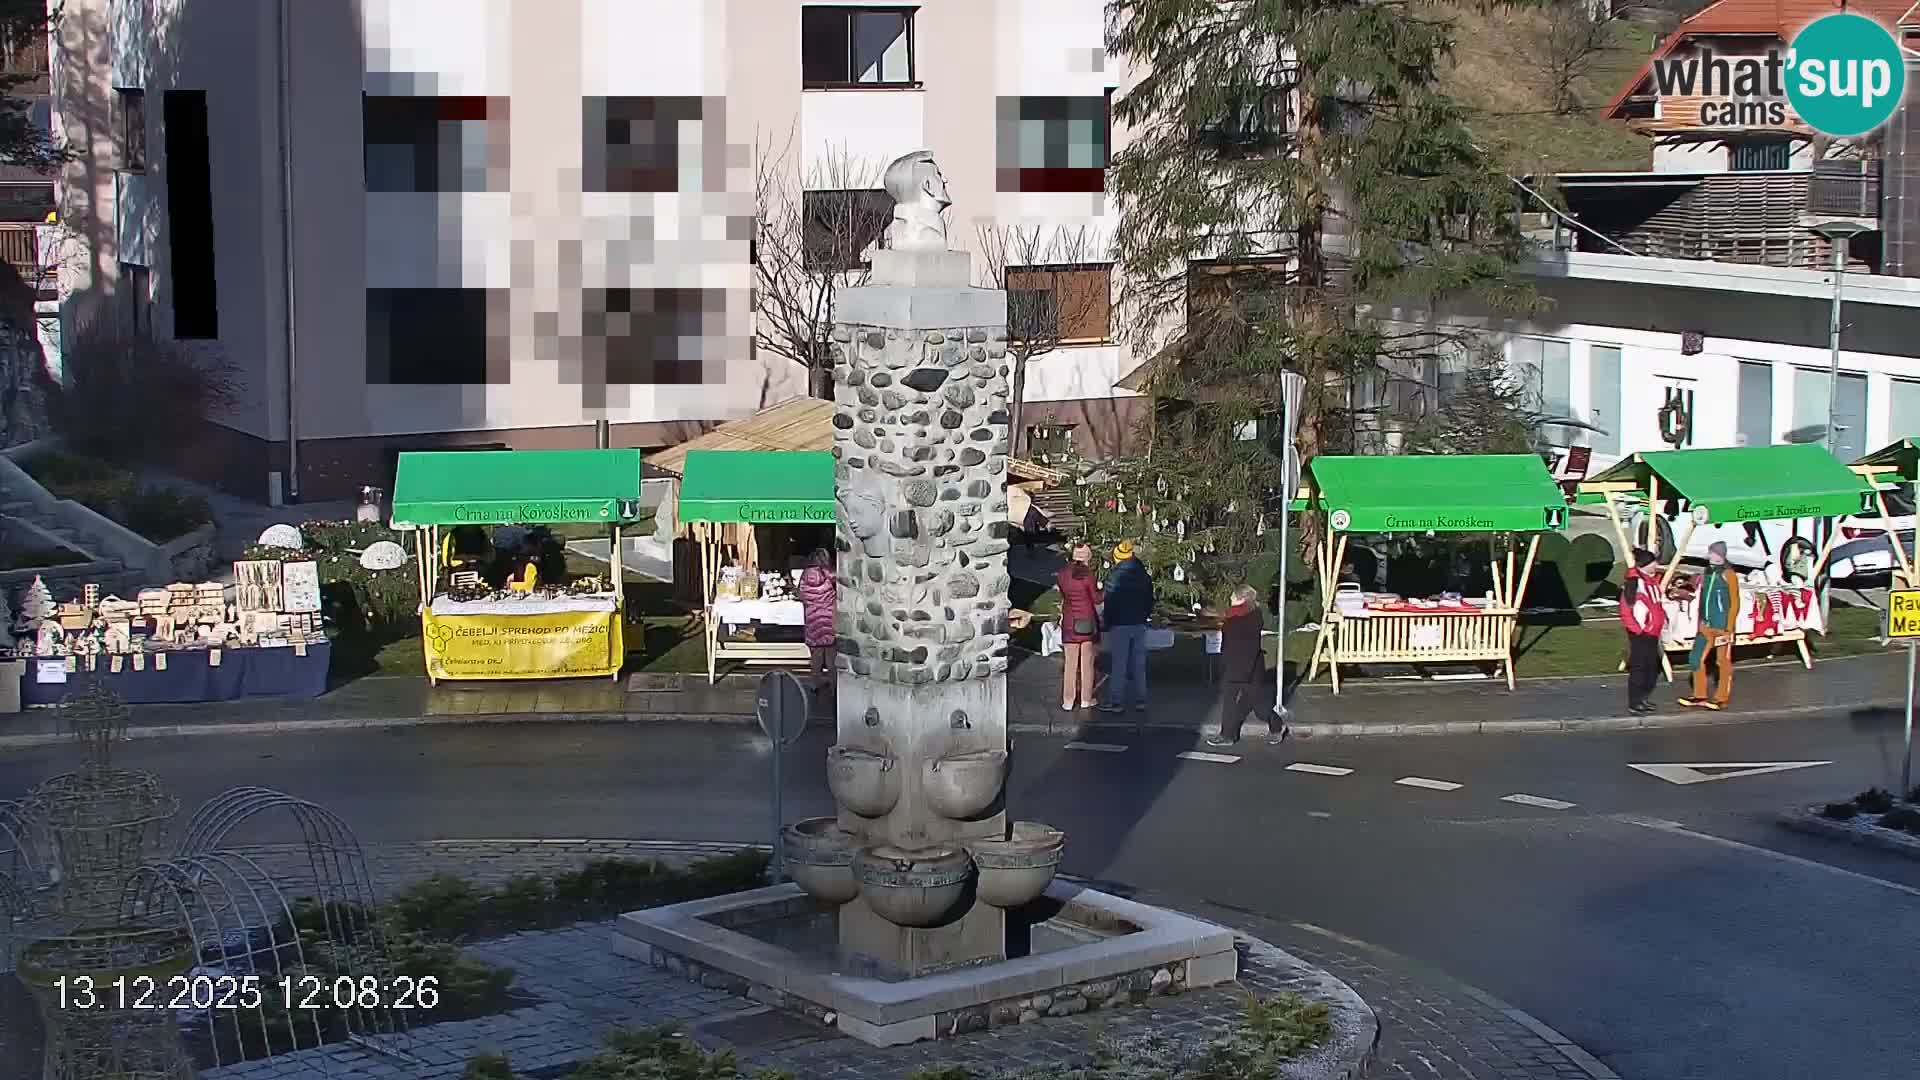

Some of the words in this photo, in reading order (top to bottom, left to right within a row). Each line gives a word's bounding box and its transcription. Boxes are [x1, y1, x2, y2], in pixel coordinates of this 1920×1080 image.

[455, 504, 489, 521] Črna
[496, 510, 513, 521] na
[518, 503, 591, 521] Koroškem
[739, 502, 776, 520] Črna
[780, 510, 797, 520] na
[1386, 514, 1416, 528] Črna
[1419, 518, 1433, 528] na
[1437, 514, 1494, 528] Koroškem
[501, 626, 552, 636] SPREHOD
[1893, 616, 1920, 633] Me
